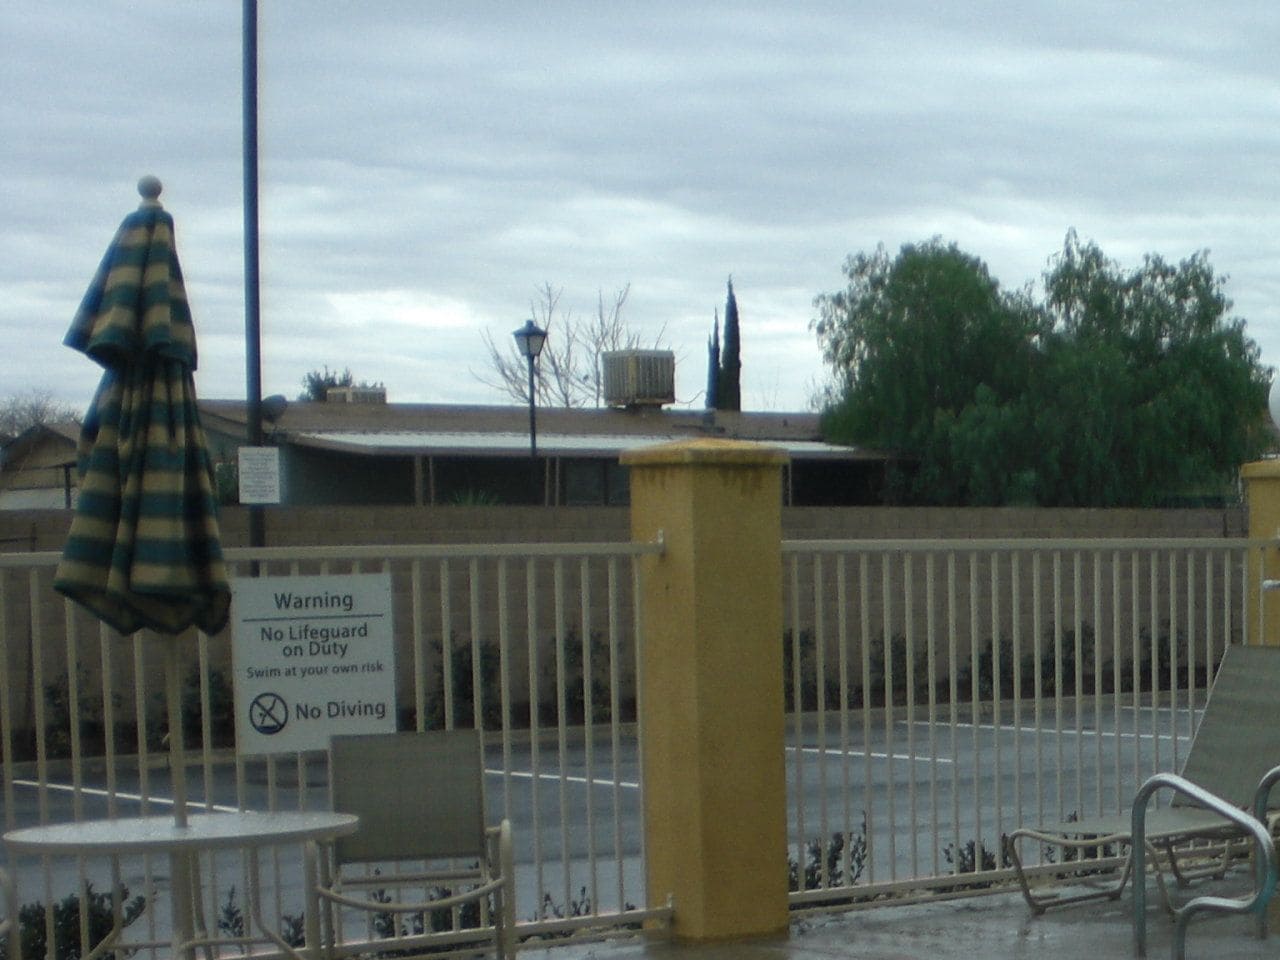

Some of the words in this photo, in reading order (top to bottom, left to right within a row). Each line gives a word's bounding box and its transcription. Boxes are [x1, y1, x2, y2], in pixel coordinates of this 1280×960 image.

[274, 592, 354, 612] Warning
[260, 627, 284, 641] No
[289, 622, 368, 643] Lifeguard
[282, 645, 303, 657] on
[309, 641, 348, 658] Duty
[246, 666, 281, 679] Swim
[285, 666, 297, 677] at
[301, 666, 328, 679] your
[332, 664, 358, 674] own
[361, 660, 383, 673] risk
[296, 703, 321, 719] No
[327, 700, 386, 718] Diving
